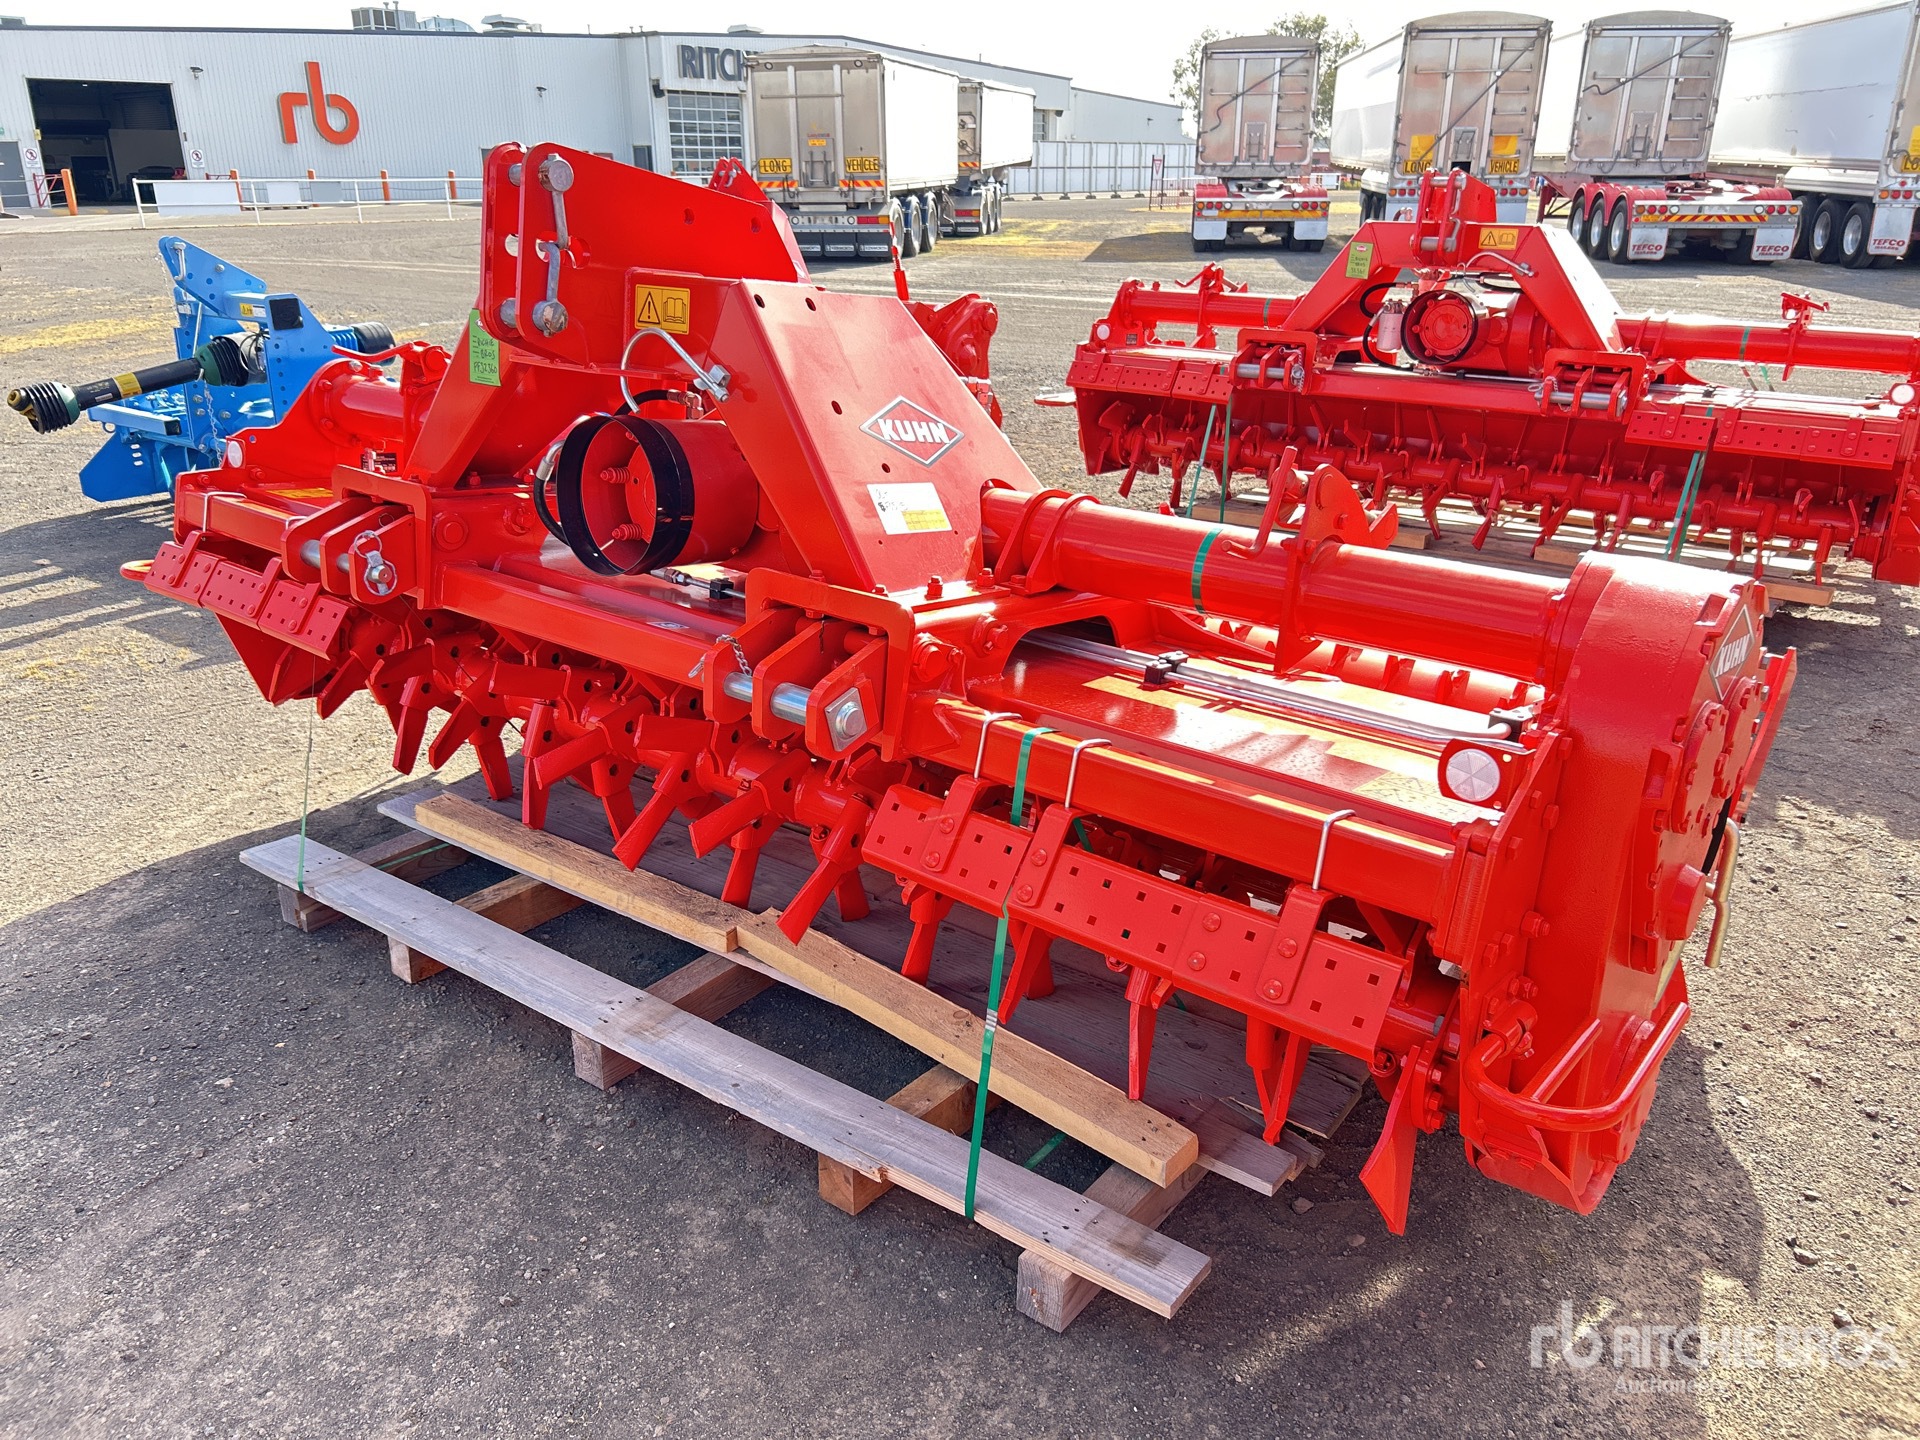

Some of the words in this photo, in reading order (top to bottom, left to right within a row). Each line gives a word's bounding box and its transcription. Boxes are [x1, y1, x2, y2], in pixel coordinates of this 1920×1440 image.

[277, 61, 359, 145] rb
[763, 160, 787, 173] LONG
[846, 158, 879, 171] VEHICLE
[1490, 159, 1518, 173] VEHICLE
[1872, 239, 1906, 247] TEFCO
[877, 418, 951, 444] KUHN
[1715, 633, 1750, 678] KUHN
